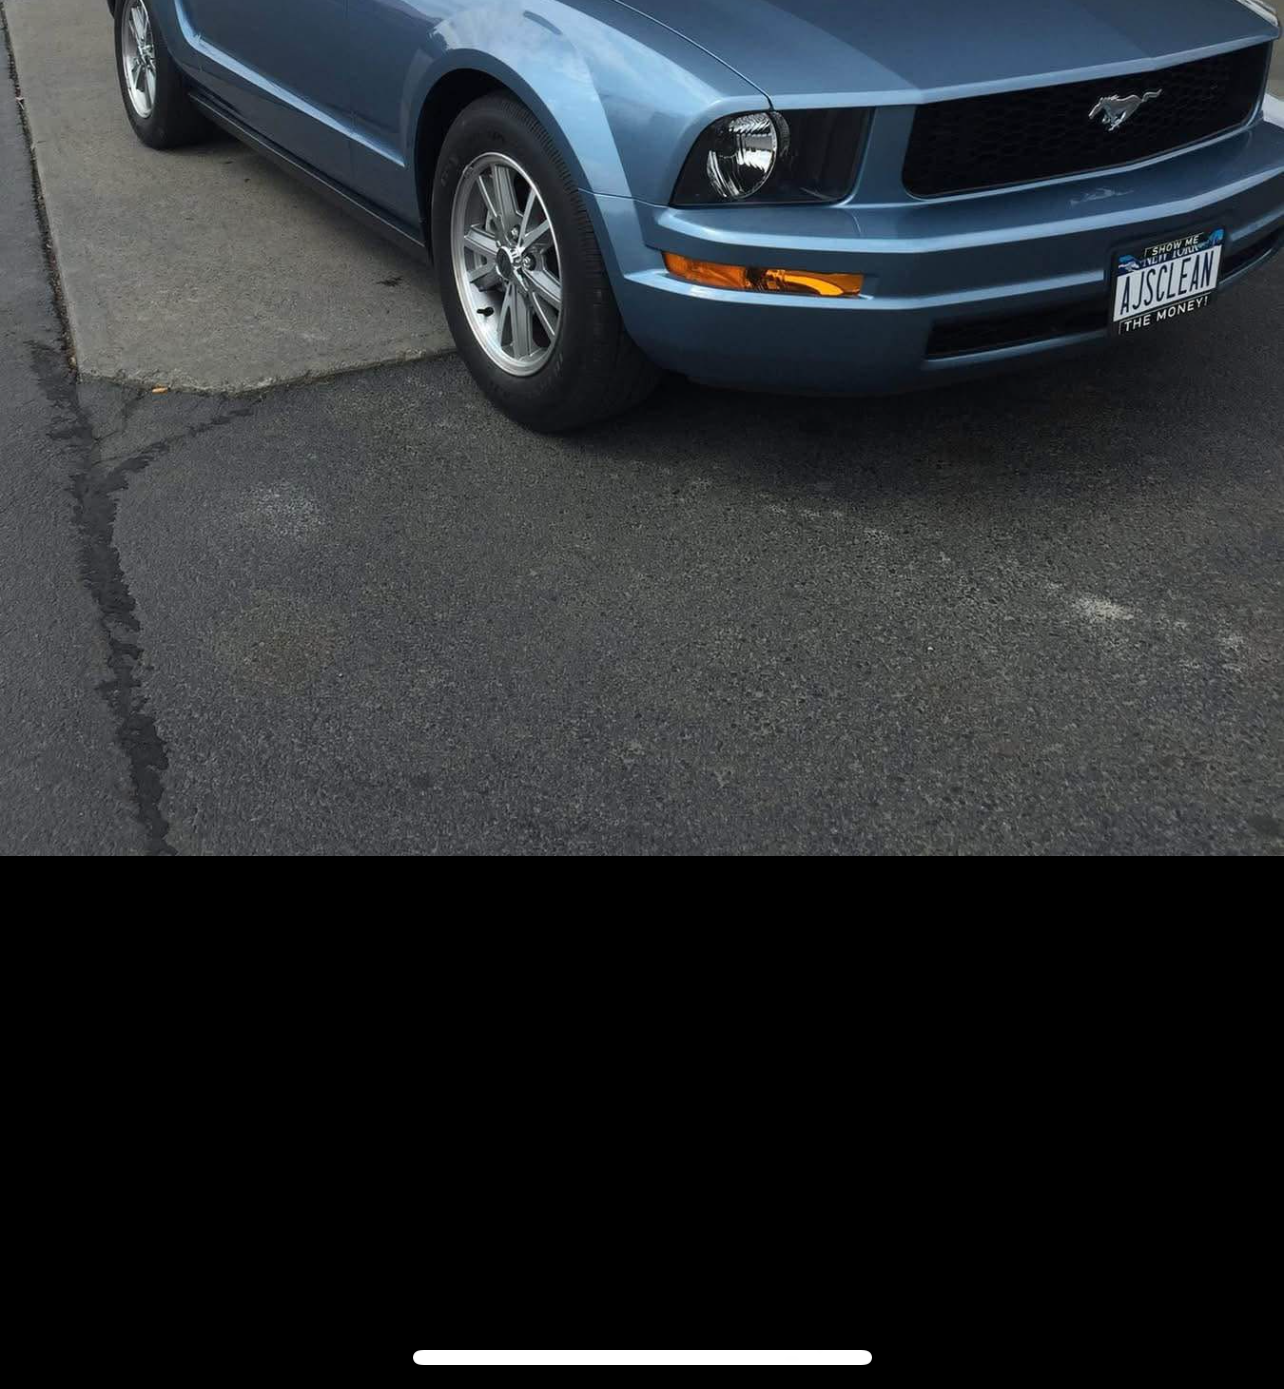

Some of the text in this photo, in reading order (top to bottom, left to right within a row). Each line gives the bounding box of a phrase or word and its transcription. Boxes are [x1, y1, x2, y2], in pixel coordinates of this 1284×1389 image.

[1152, 235, 1201, 256] SHOW ME
[1119, 249, 1214, 315] AJSCLEAN
[1124, 296, 1209, 332] THE MONEY!
